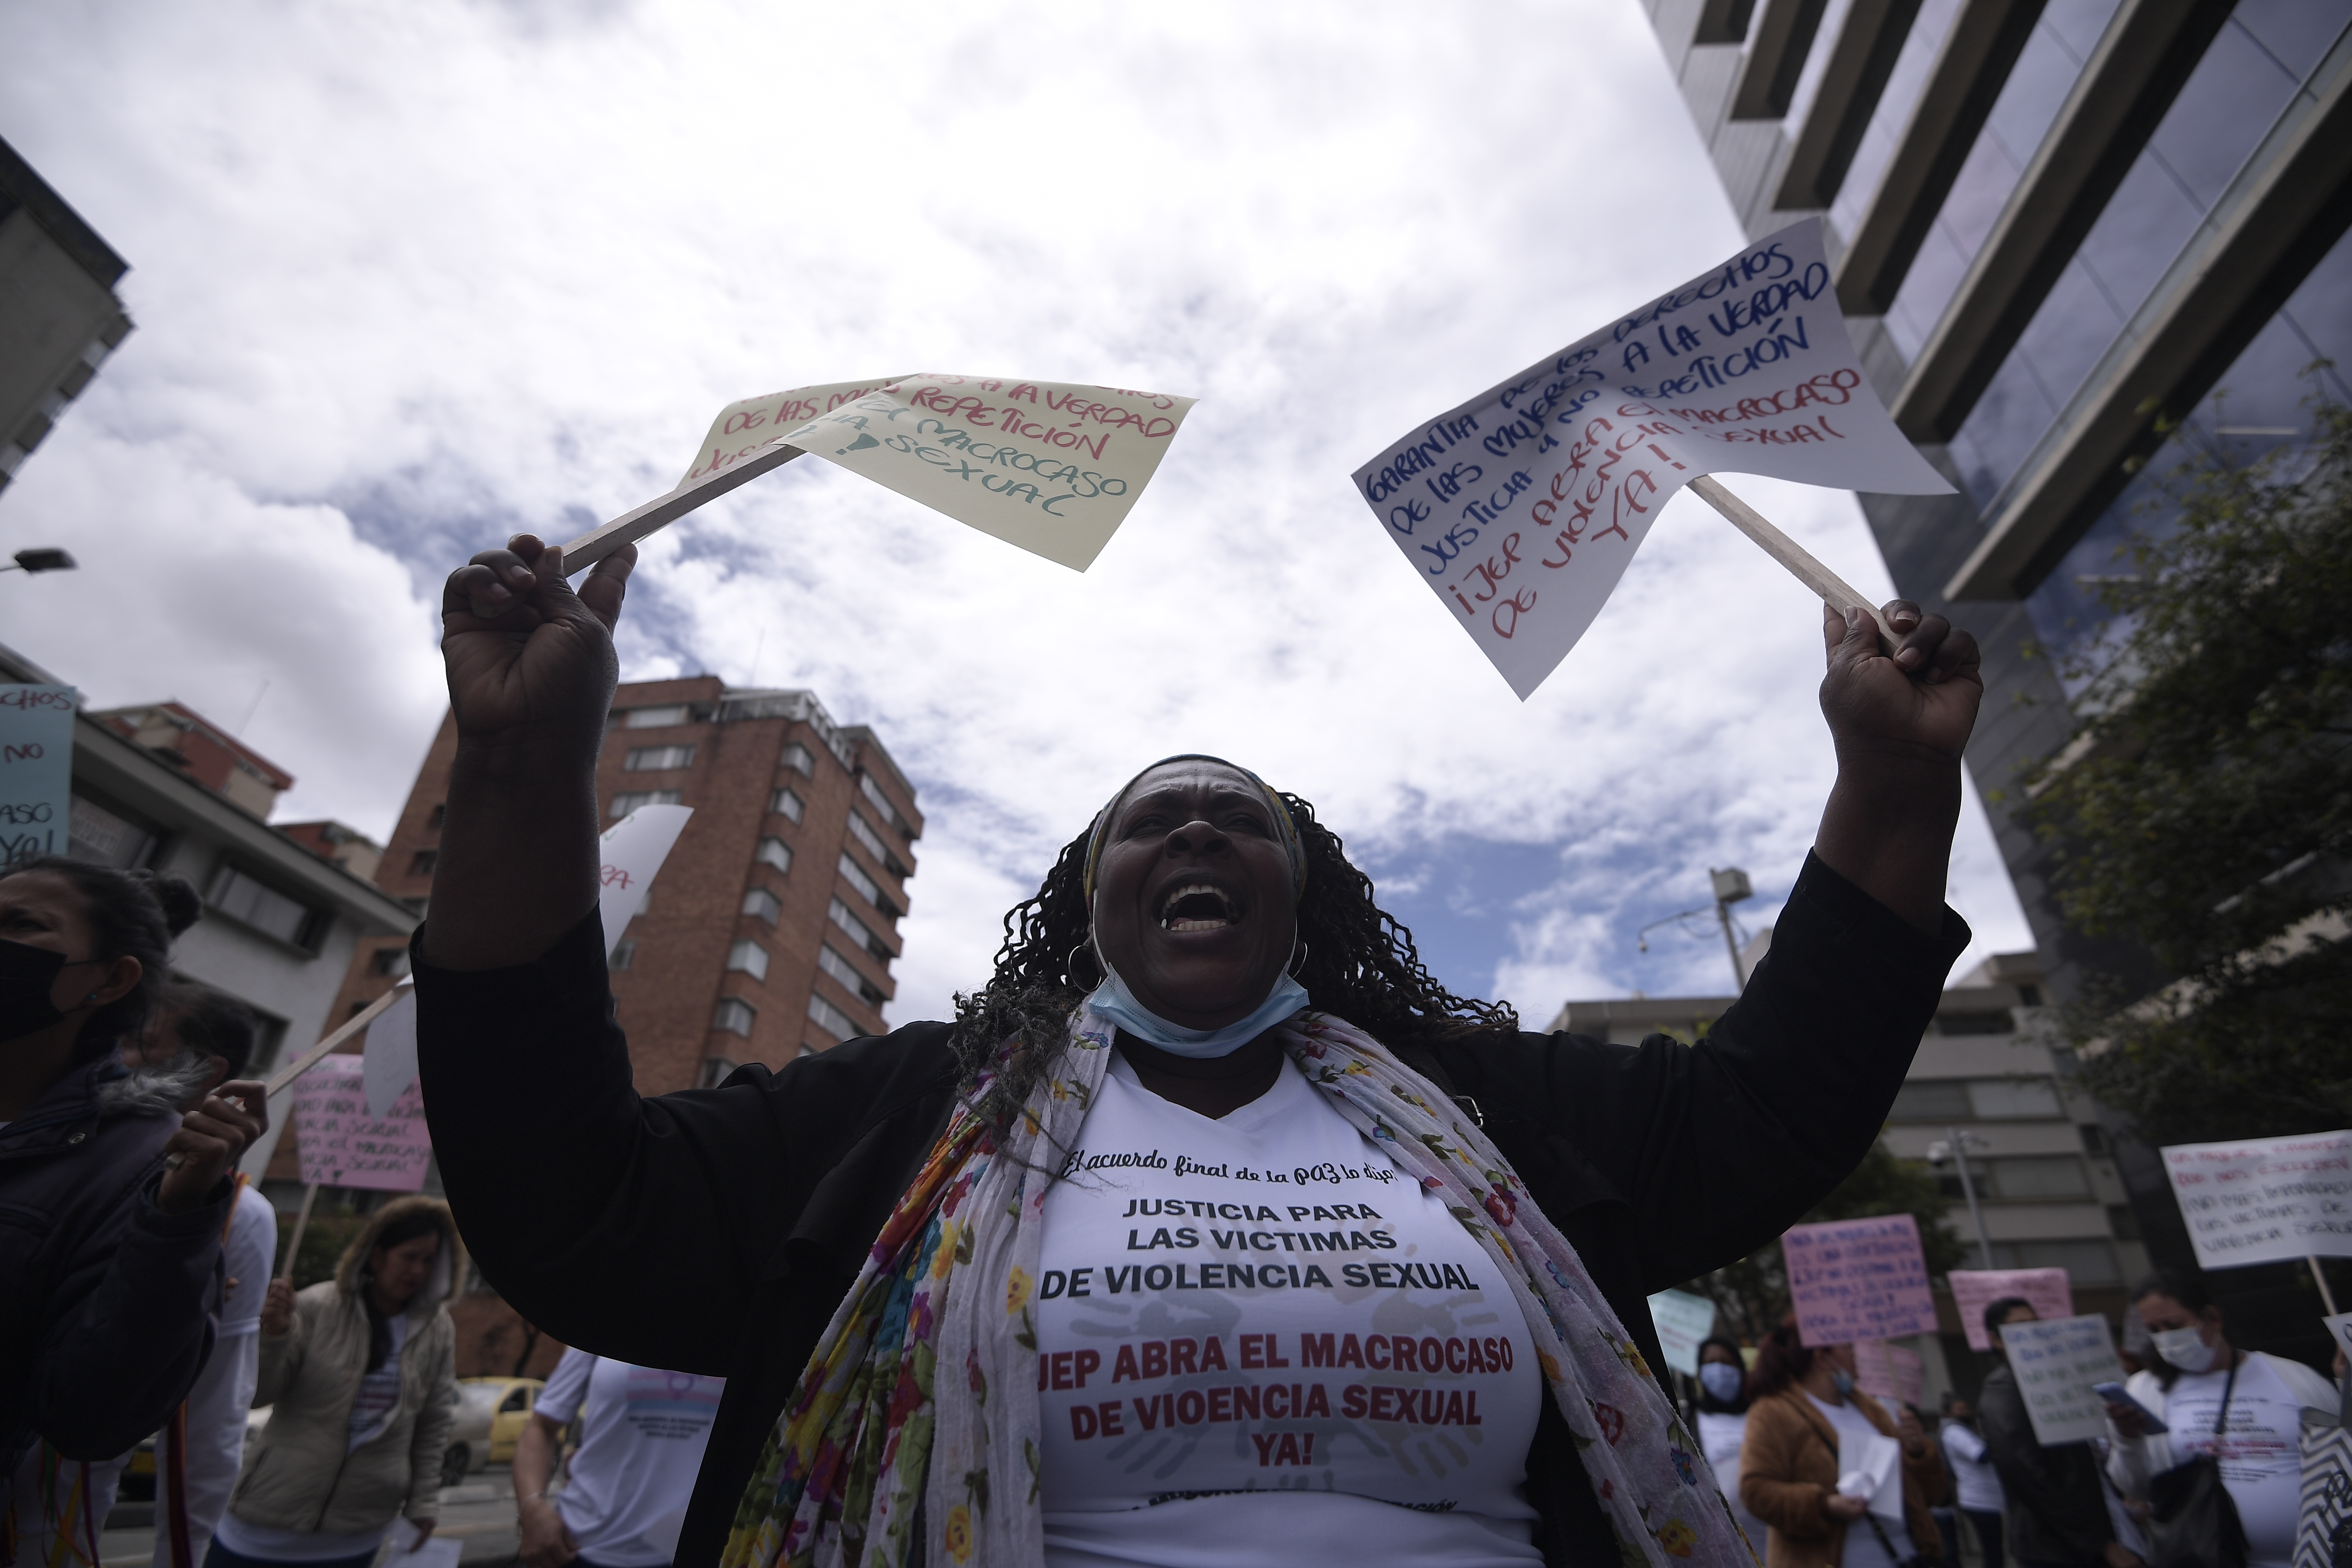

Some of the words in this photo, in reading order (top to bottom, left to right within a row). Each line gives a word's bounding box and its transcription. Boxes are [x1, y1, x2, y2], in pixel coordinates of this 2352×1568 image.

[1500, 376, 1538, 409] DE
[1614, 243, 1794, 343] DERECHOS
[724, 408, 768, 435] DE
[910, 386, 1111, 460] REPETICIÓN
[978, 379, 1004, 392] A
[1047, 390, 1175, 437] VERDAD
[1391, 498, 1431, 535] DE
[1483, 366, 1604, 457] MUJERES
[1622, 341, 1650, 373] A
[1709, 262, 1828, 336] VERDAD
[917, 418, 1127, 498] MACROCASO
[1421, 466, 1533, 575] JUSTICIA
[1558, 390, 1600, 424] NO
[1621, 316, 1809, 399] REPETICIÓN
[1532, 417, 1613, 526] ABRA
[1669, 369, 1860, 423] MACROCASO
[1492, 584, 1538, 639] DE
[1541, 422, 1685, 569] VIOLENCIA
[5, 743, 44, 763] NO
[1086, 1149, 1167, 1171] acuerdo
[1173, 1154, 1230, 1177] final
[1235, 1167, 1261, 1181] de
[1266, 1171, 1290, 1183] la
[1340, 1163, 1360, 1179] lo
[1122, 1198, 1282, 1222] JUSTICIA
[1287, 1203, 1384, 1222] PARA
[1127, 1227, 1200, 1250] LAS
[1209, 1228, 1397, 1251] VICTIMAS
[1040, 1267, 1094, 1299] DE
[1105, 1263, 1333, 1294] VIOLENCIA
[1342, 1262, 1480, 1290] SEXUAL
[1037, 1349, 1100, 1392] JEP
[1112, 1335, 1228, 1384] ABRA
[1239, 1333, 1289, 1369] EL
[1301, 1333, 1514, 1374] MACROCASO
[1070, 1400, 1125, 1441] DE
[1132, 1383, 1331, 1432] VIOENCIA
[1340, 1383, 1482, 1426] SEXUAL
[1251, 1432, 1315, 1467] YA!
